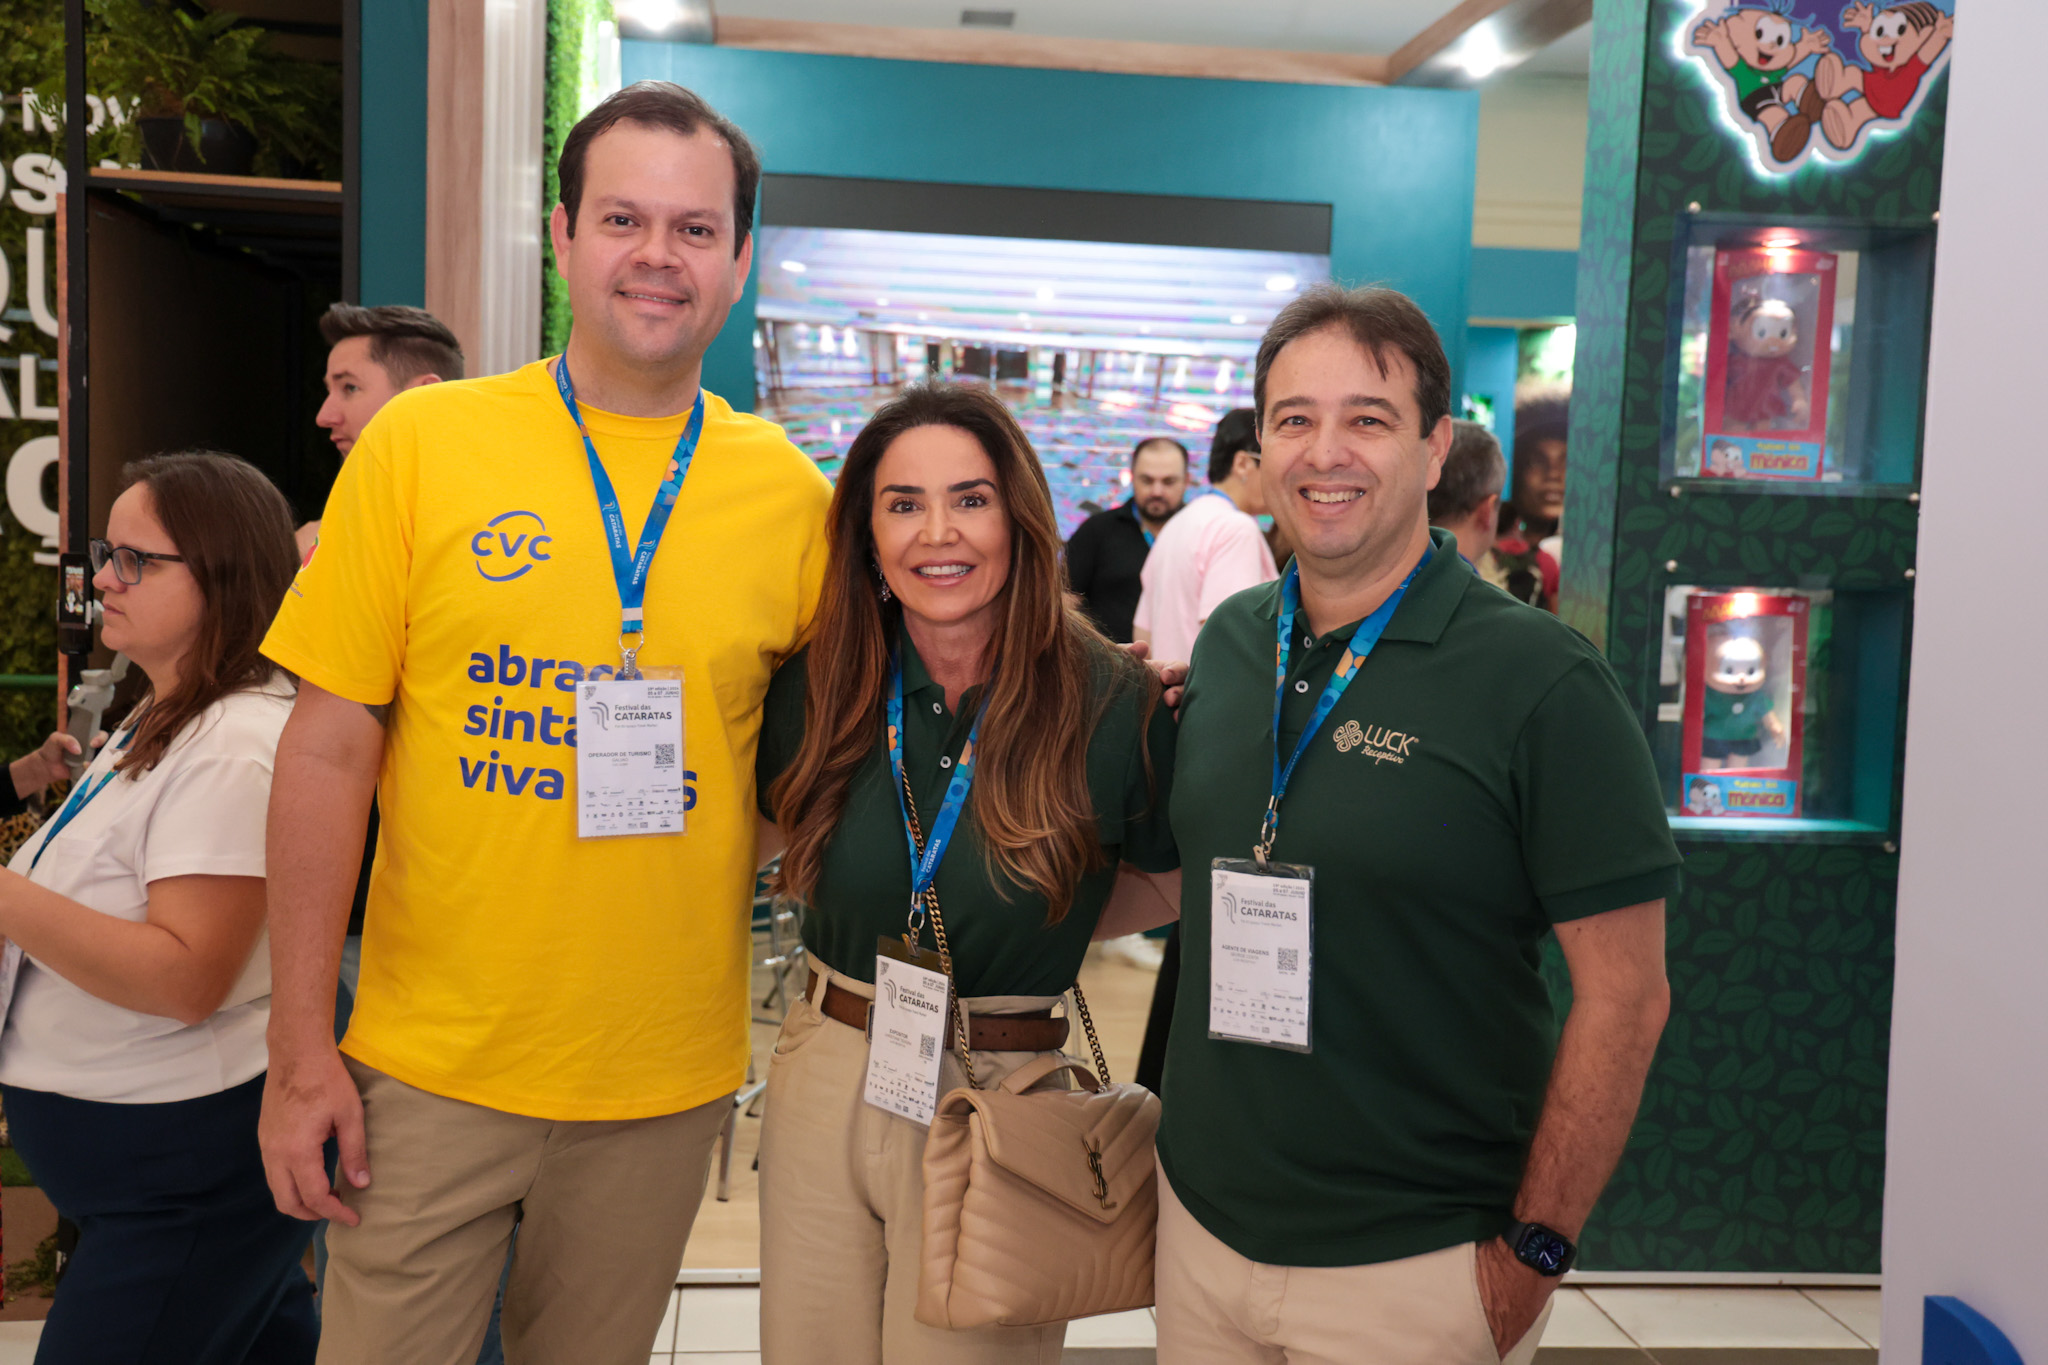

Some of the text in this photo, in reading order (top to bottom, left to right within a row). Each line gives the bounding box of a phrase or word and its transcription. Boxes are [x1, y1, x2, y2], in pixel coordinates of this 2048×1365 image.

[0, 153, 66, 214] S
[471, 530, 553, 561] CVC
[609, 513, 622, 549] CATARATAS
[632, 551, 647, 585] CATARATAS
[614, 711, 672, 721] CATARATAS
[1363, 724, 1416, 757] LUCK
[458, 750, 565, 801] viva
[926, 839, 941, 873] CATARATAS
[1240, 898, 1276, 908] Festival das
[1240, 907, 1297, 921] CATARATAS
[899, 994, 939, 1013] CATARATAS
